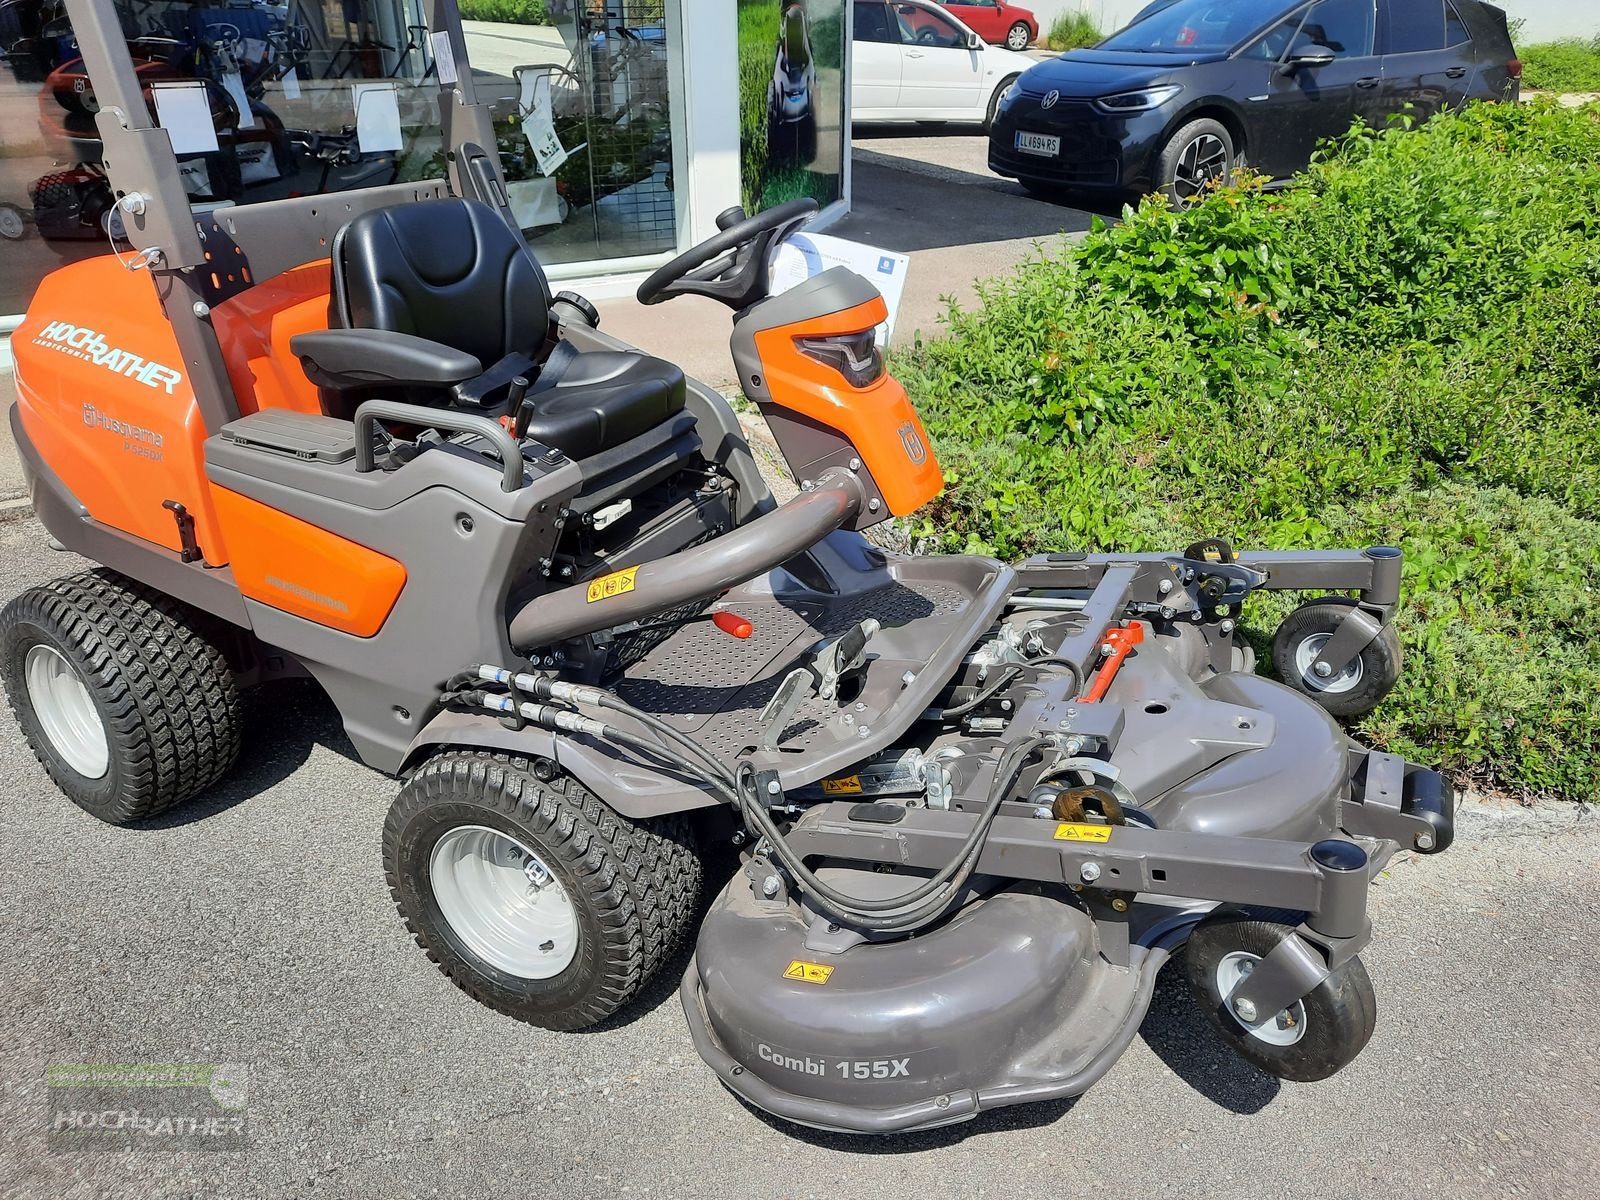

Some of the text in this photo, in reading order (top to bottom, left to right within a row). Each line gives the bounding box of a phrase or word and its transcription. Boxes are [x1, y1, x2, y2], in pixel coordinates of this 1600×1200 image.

[32, 338, 91, 362] LANDTECHNIK
[38, 320, 182, 394] HOCHRATHER
[96, 410, 163, 447] Husqvarna
[758, 1043, 911, 1079] Combi 155X
